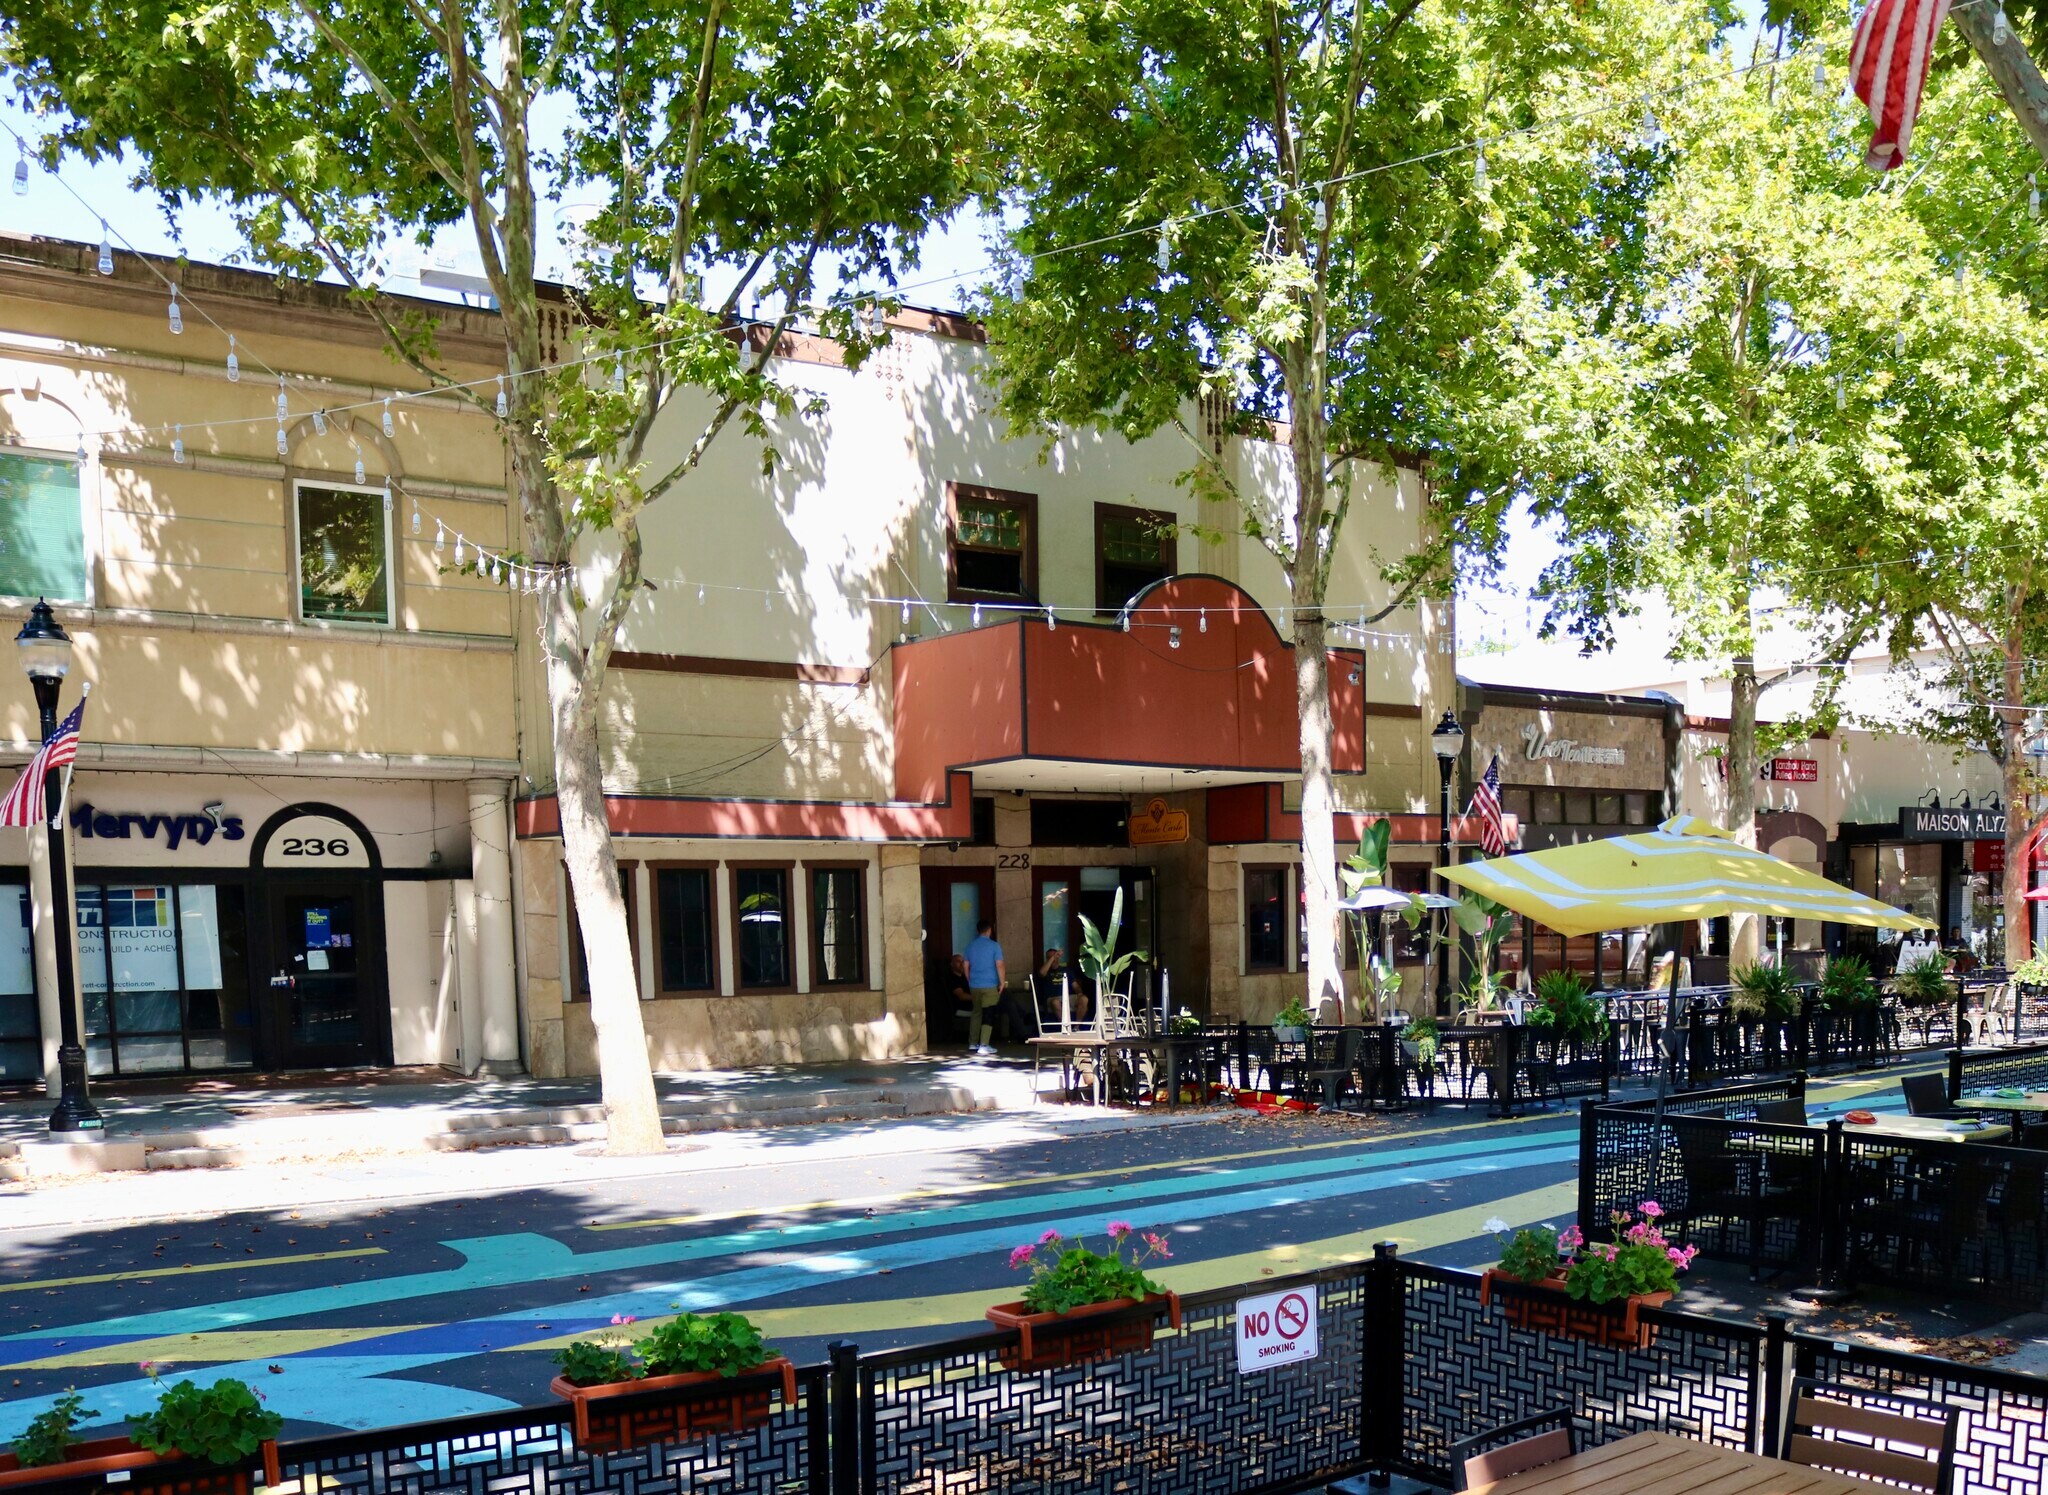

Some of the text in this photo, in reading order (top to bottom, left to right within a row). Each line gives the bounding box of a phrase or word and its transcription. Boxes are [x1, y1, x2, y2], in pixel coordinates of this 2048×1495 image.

[1775, 760, 1816, 771] Lanzhou Hand
[1775, 770, 1816, 781] Pulled Noodles
[1134, 820, 1184, 835] Monte Carlo
[1916, 812, 2006, 832] MAISON ALYZ
[282, 838, 350, 857] 236
[998, 853, 1030, 870] 228
[77, 929, 178, 940] ONSTRUCTIO
[78, 945, 95, 954] IGN
[111, 945, 132, 954] UILD
[143, 944, 178, 953] ACHIEV
[1244, 1311, 1270, 1339] NO
[1258, 1341, 1296, 1358] SMOKING
